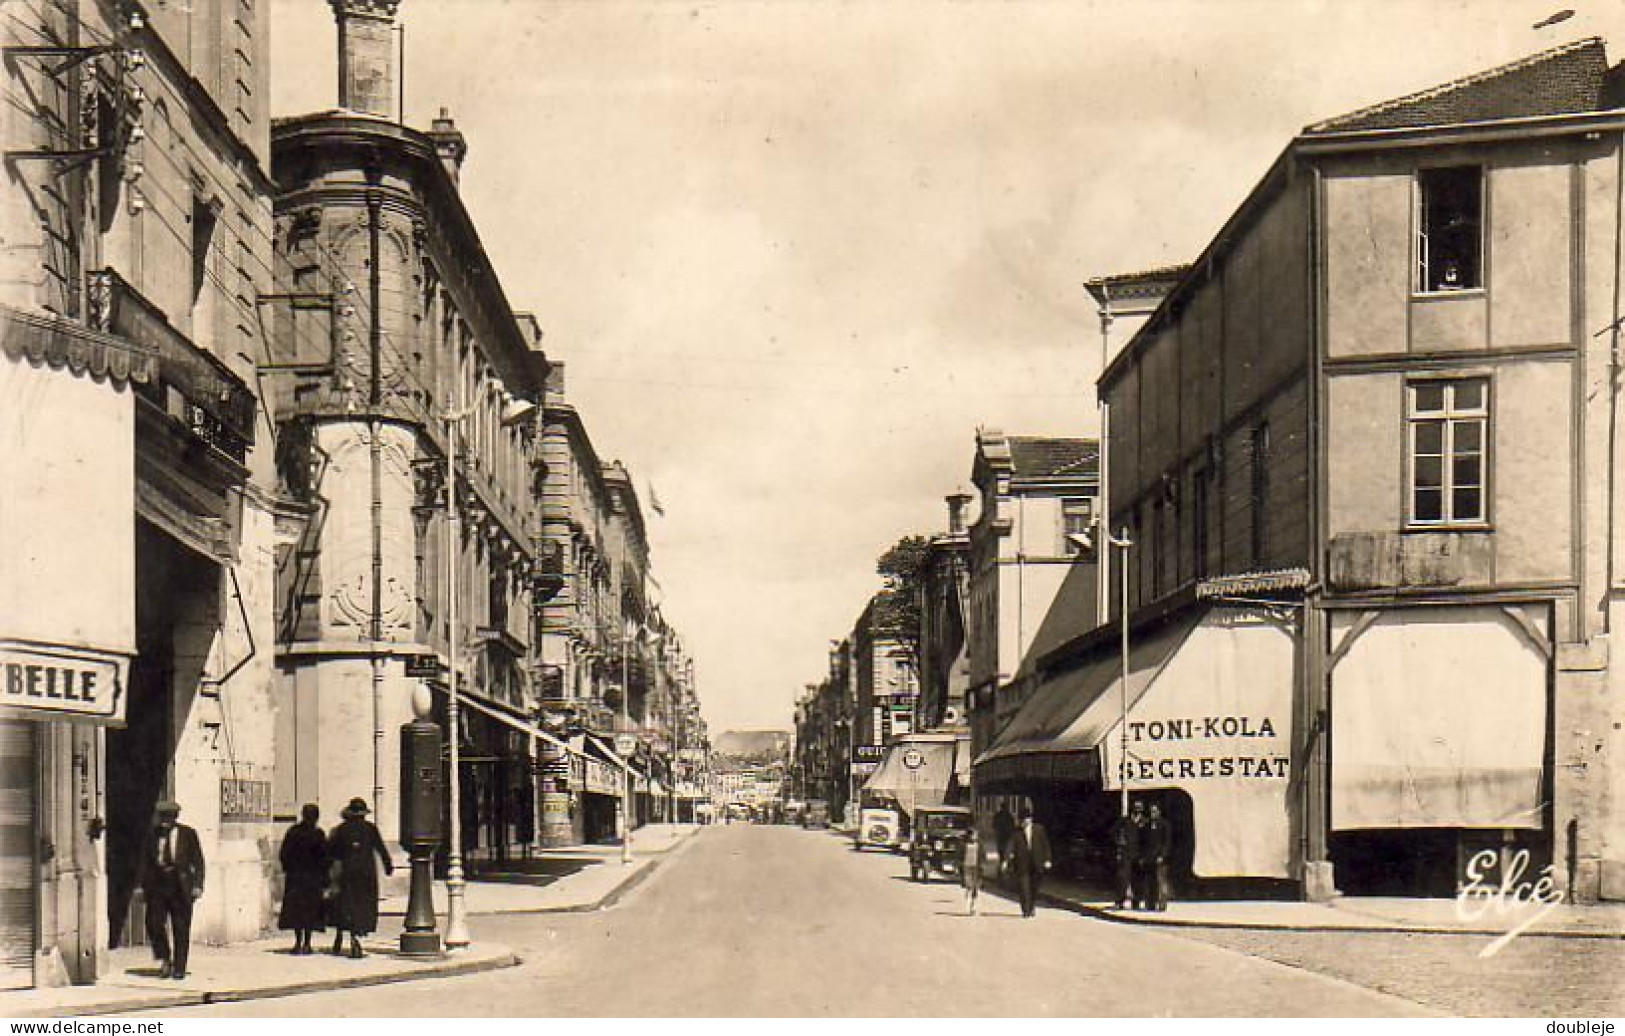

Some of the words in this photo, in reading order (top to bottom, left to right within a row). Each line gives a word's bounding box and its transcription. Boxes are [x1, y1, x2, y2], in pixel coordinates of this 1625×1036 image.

[0, 663, 97, 702] BELLE
[1129, 717, 1276, 741] TONI-KOLA
[1118, 757, 1289, 781] SECRESTAT
